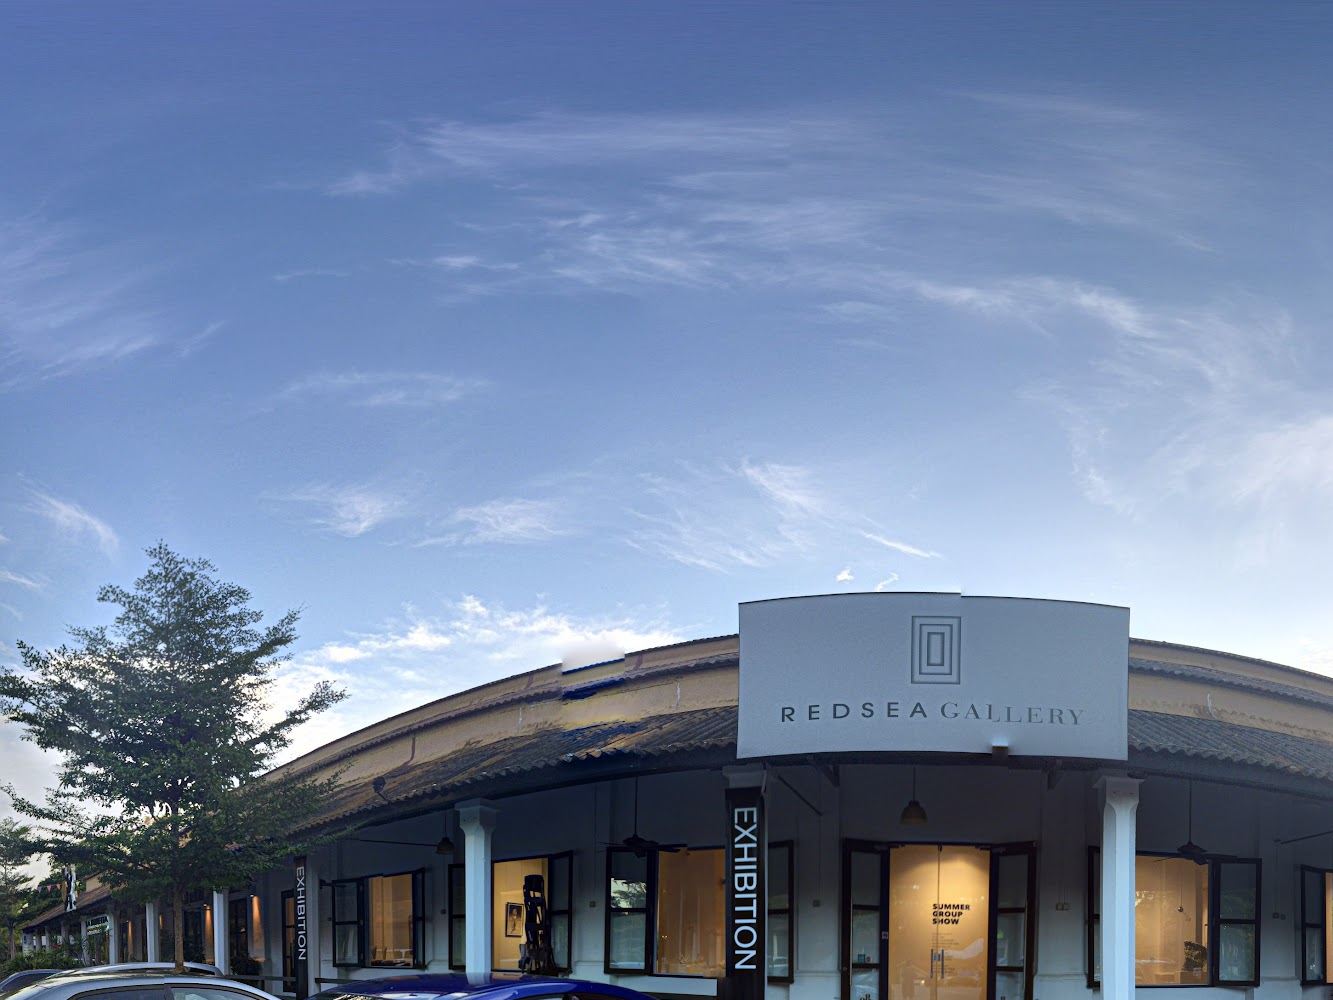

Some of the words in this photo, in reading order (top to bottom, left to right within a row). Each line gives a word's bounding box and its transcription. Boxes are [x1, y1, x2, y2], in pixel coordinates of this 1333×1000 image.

[780, 702, 928, 723] REDSEA
[940, 701, 1086, 725] GALLERY
[296, 866, 306, 960] EXHIBITION
[734, 807, 757, 970] EXHIBITION
[932, 903, 971, 911] SUMMER
